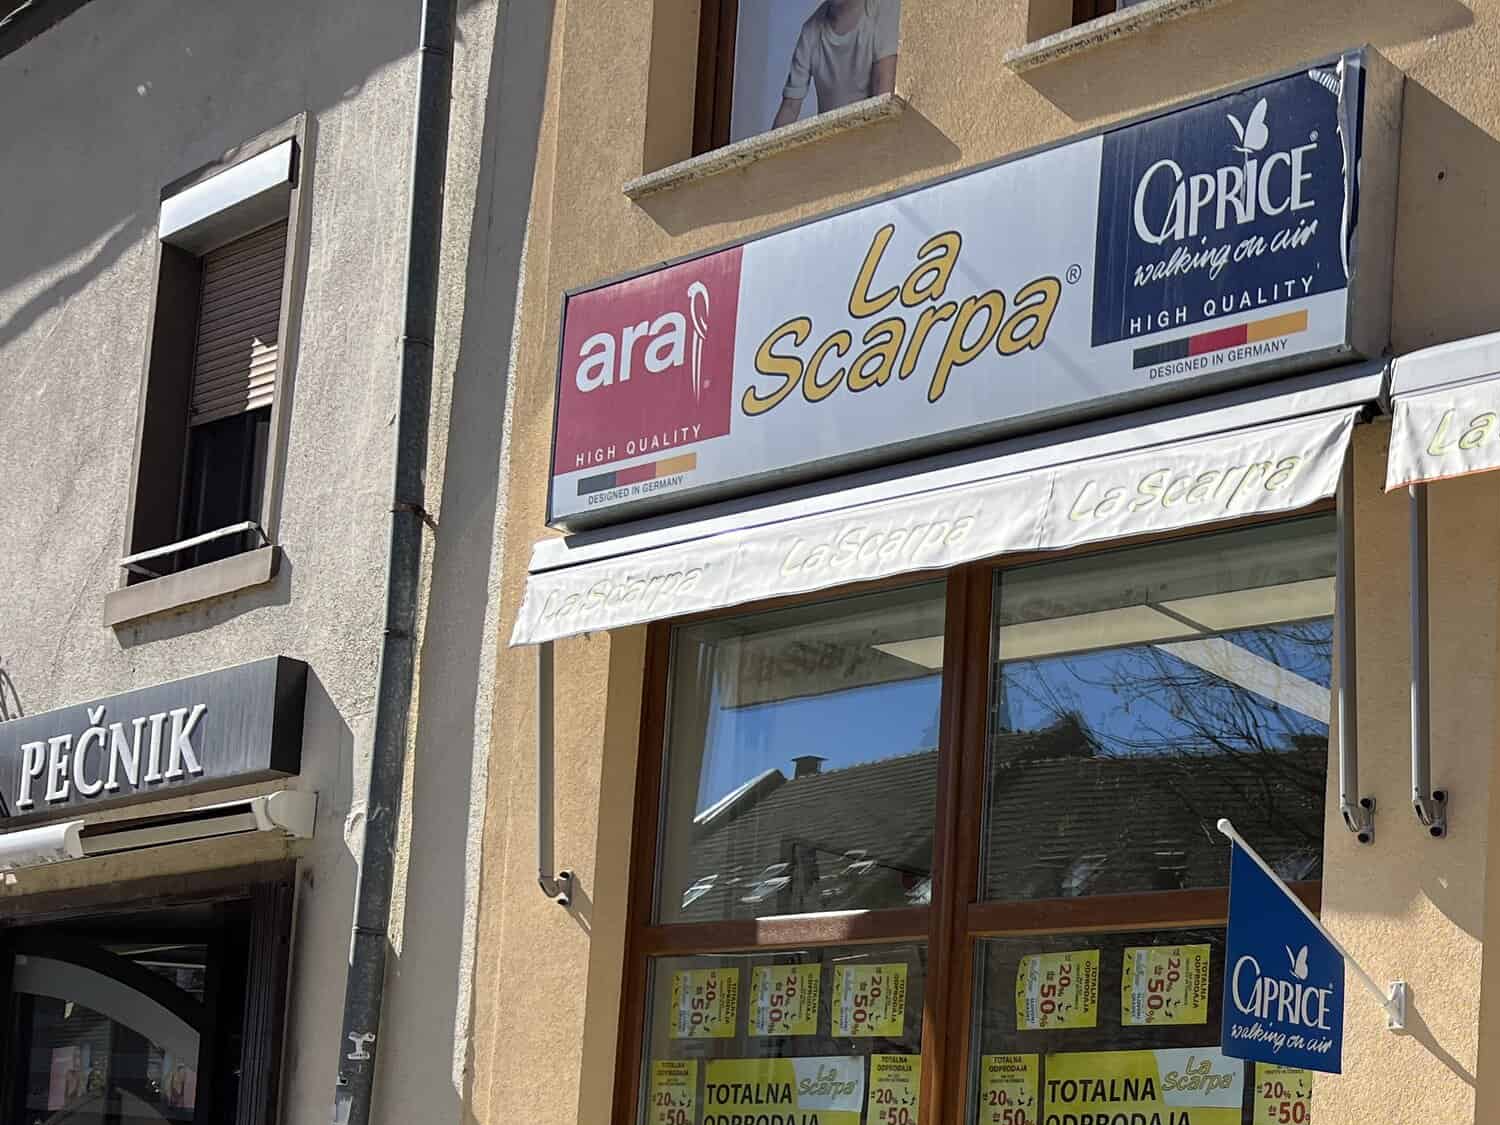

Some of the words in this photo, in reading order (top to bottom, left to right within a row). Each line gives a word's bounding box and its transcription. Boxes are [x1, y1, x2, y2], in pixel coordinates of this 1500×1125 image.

[1134, 143, 1318, 244] CAPRICE
[848, 224, 962, 318] La
[1134, 236, 1231, 287] walking
[1233, 236, 1269, 262] on
[1270, 220, 1318, 253] air
[1130, 306, 1187, 334] HIGH
[1204, 276, 1313, 317] QUALITY
[576, 311, 686, 392] ara
[742, 276, 1061, 416] Scarpa
[1150, 351, 1208, 379] DESIGNED
[1212, 350, 1223, 364] IN
[1228, 339, 1288, 361] GERMANY
[576, 446, 616, 466] HIGH
[627, 424, 702, 455] QUALITY
[1427, 408, 1496, 456] La
[589, 487, 630, 505] DESIGNED
[631, 487, 640, 495] IN
[642, 476, 684, 493] GERMANY
[1068, 480, 1127, 520] La
[1129, 456, 1300, 513] Scarpa
[780, 538, 830, 576] La
[830, 515, 975, 563] Scarpa
[16, 704, 207, 809] PEČNIK
[1232, 955, 1333, 1030] CAPRICE
[1185, 1056, 1211, 1075] La
[1231, 1022, 1286, 1054] walking
[1287, 1033, 1305, 1048] on
[1307, 1036, 1332, 1053] air
[707, 1083, 793, 1104] TOTALNA
[1048, 1078, 1156, 1103] TOTALNA
[1161, 1071, 1233, 1098] Scarpa
